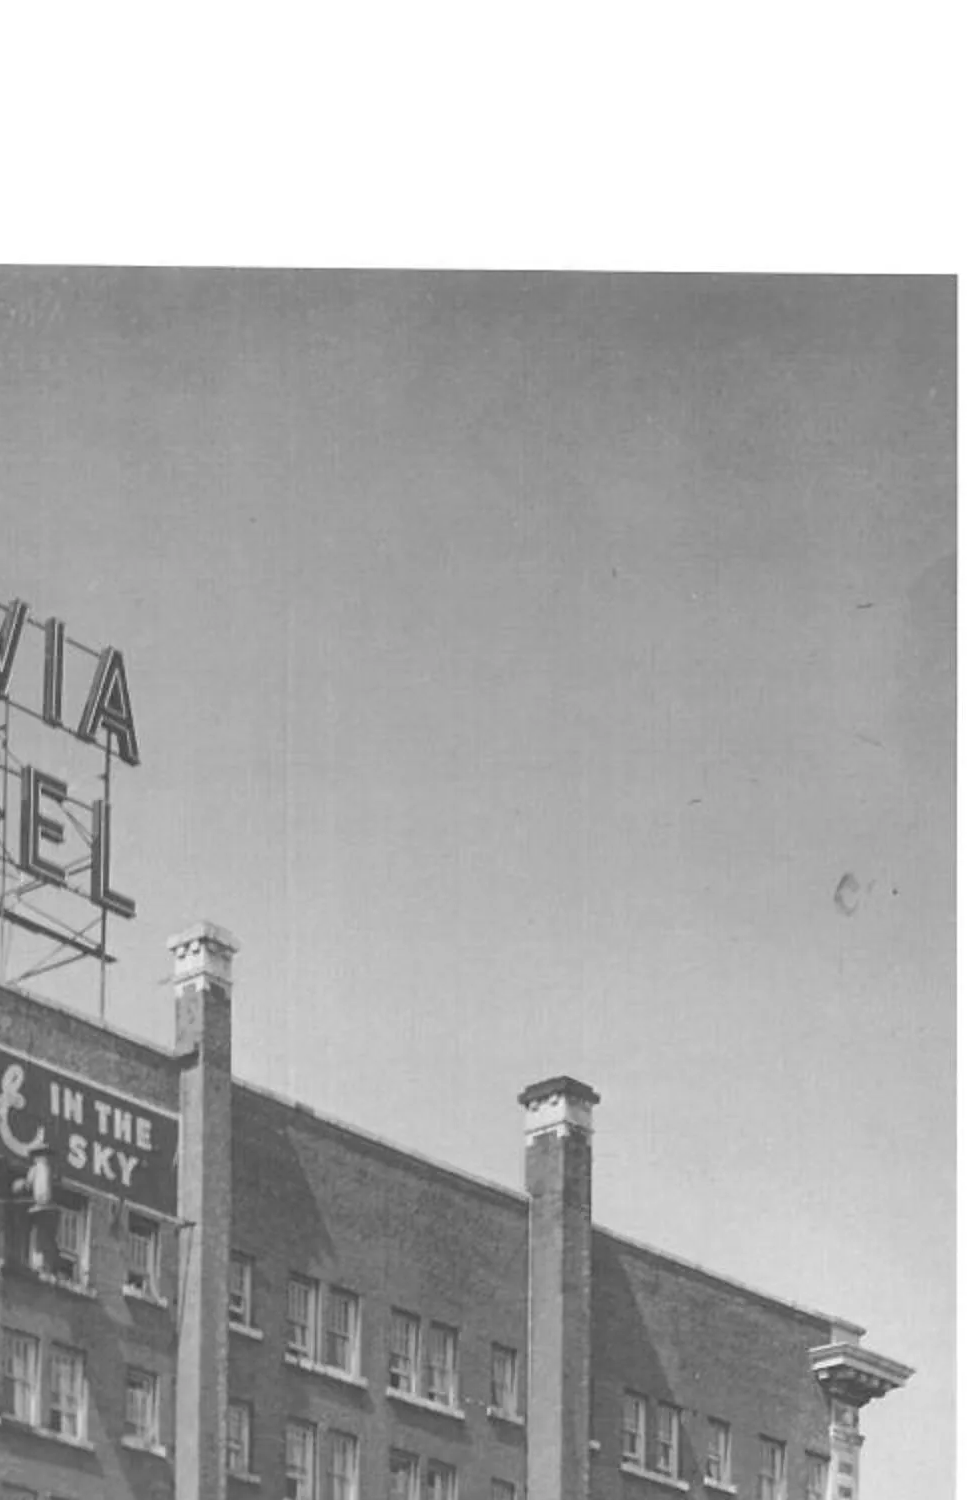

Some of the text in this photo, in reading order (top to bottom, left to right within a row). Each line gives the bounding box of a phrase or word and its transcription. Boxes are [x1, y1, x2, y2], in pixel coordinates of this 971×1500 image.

[49, 1082, 85, 1126] IN
[94, 1100, 153, 1151] THE
[66, 1133, 139, 1187] SKY
